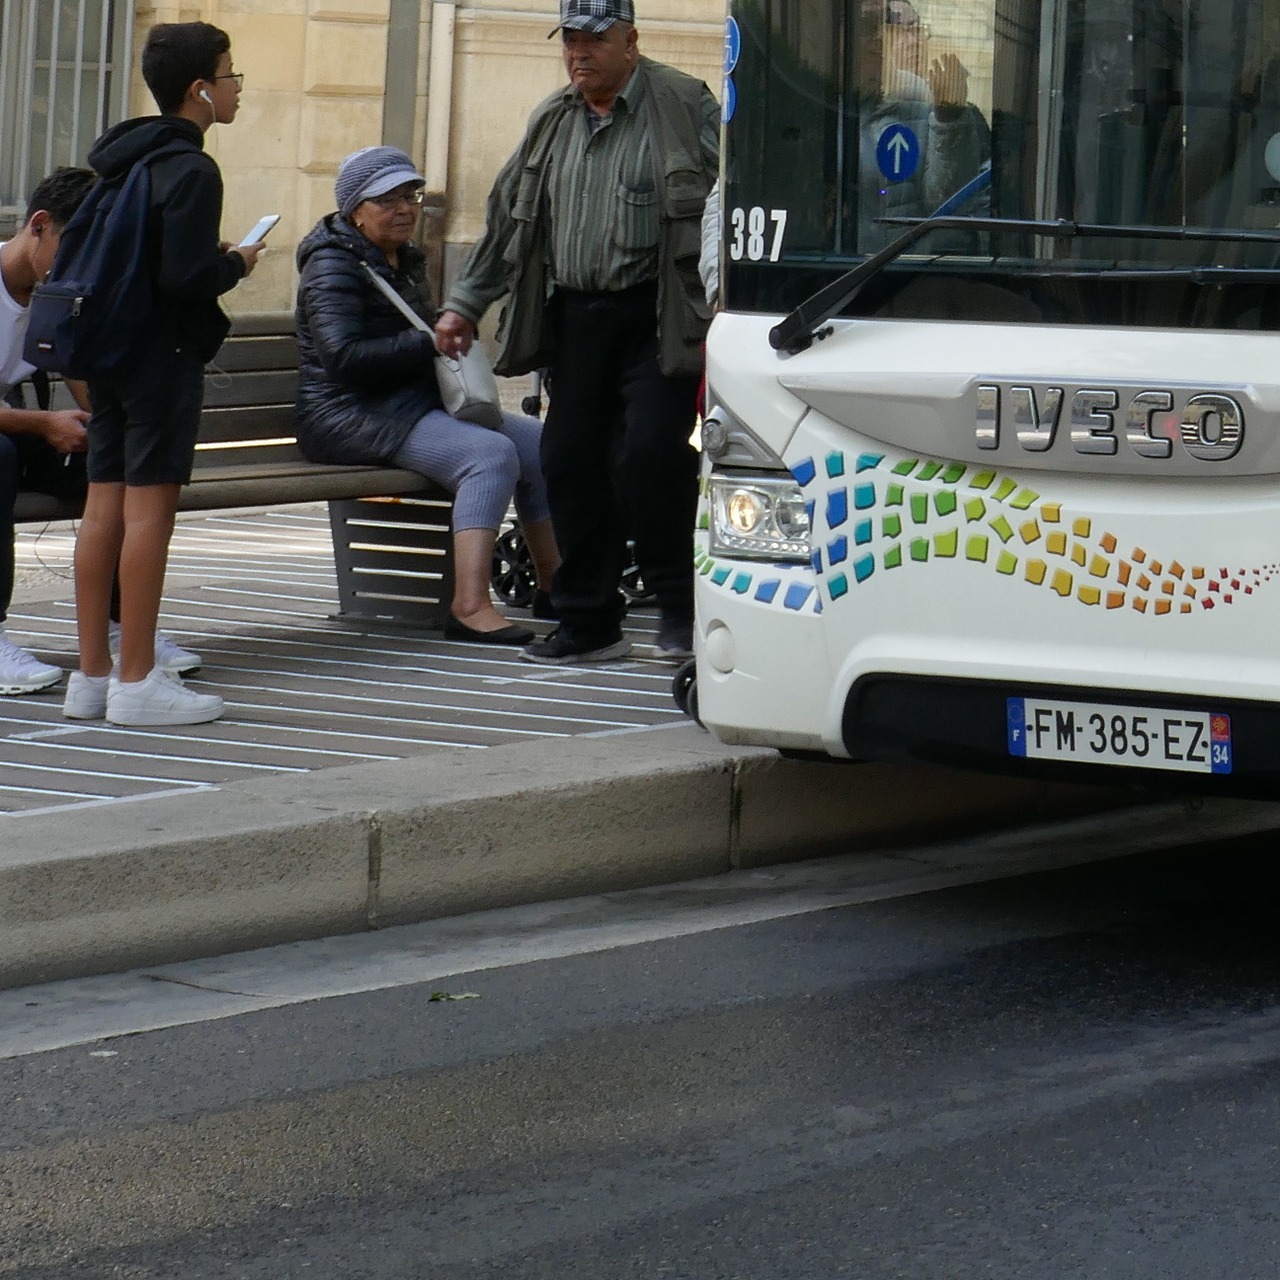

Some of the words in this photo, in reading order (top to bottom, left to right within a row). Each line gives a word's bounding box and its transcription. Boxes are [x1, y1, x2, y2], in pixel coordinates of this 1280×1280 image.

[730, 206, 788, 262] 387
[976, 384, 1246, 462] IVECO
[1013, 729, 1020, 741] F
[1034, 708, 1206, 763] FM-385-EZ
[1213, 744, 1229, 764] 34
